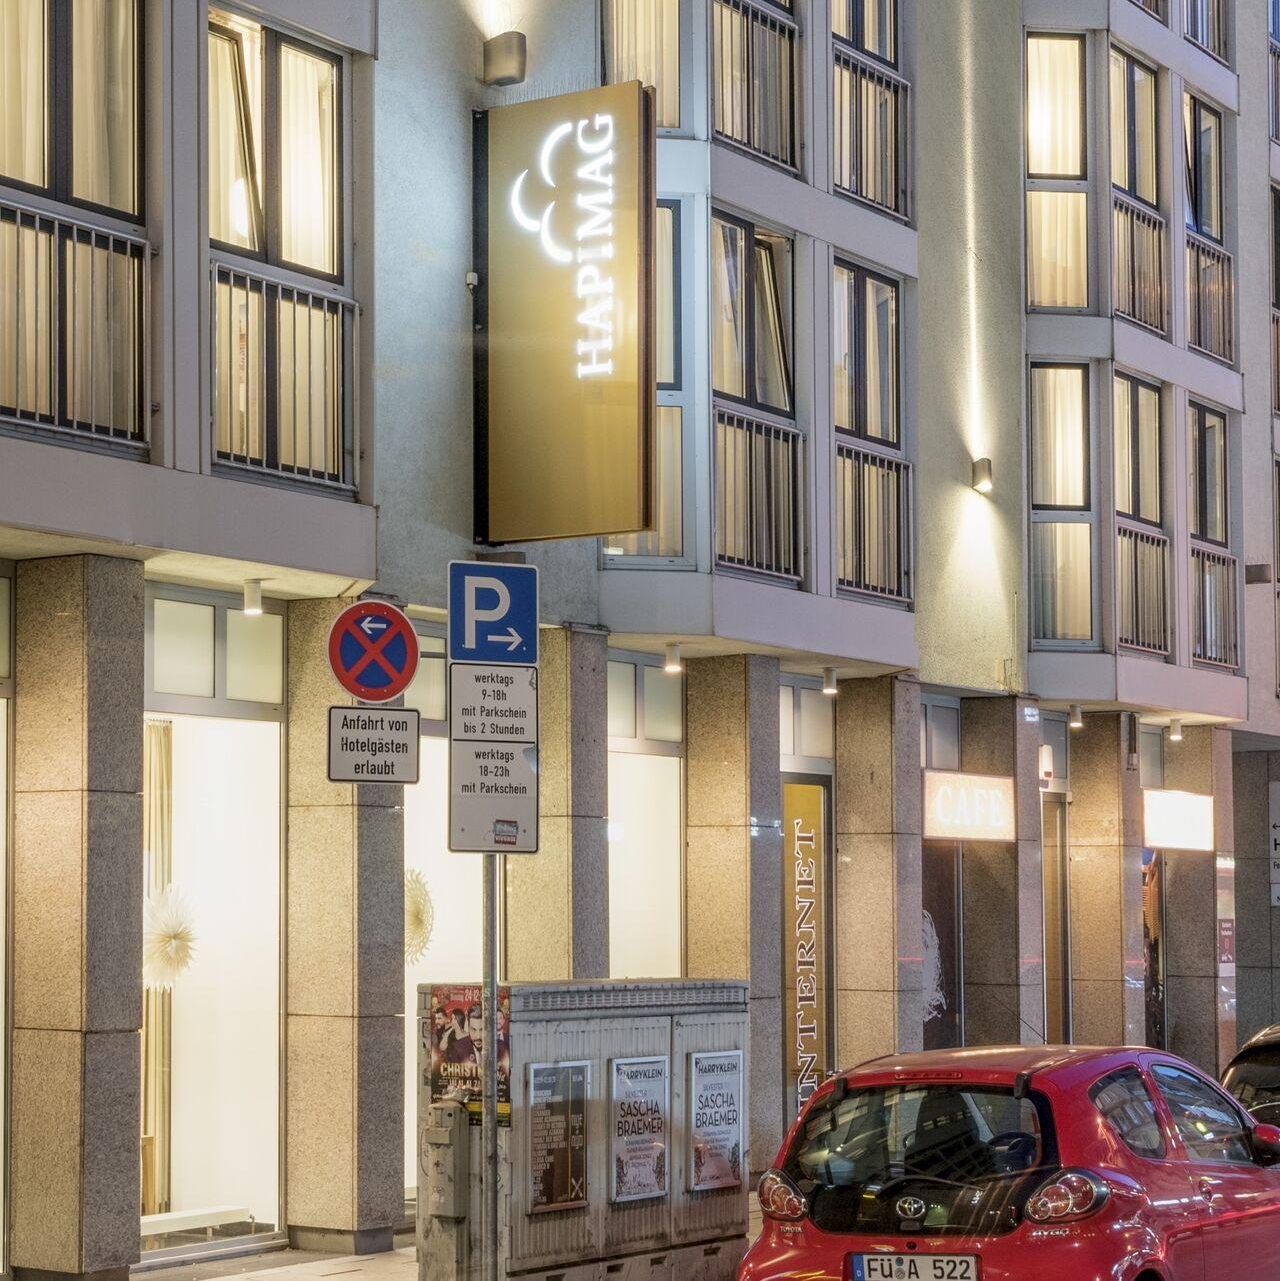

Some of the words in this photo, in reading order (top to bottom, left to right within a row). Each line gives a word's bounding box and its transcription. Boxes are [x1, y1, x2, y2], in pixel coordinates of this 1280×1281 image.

[577, 113, 613, 379] HAPIMAG
[464, 576, 511, 649] P
[474, 673, 514, 687] werktags
[481, 689, 507, 701] 9-18h
[461, 706, 476, 718] mit
[480, 706, 527, 719] Parkschein
[341, 715, 385, 732] Anfahrt
[388, 720, 408, 732] von
[464, 723, 477, 734] bis
[480, 723, 487, 734] 2
[490, 723, 525, 736] Stunden
[341, 737, 408, 756] Hotelgästen
[474, 749, 514, 762] werktags
[354, 760, 395, 776] erlaubt
[479, 765, 510, 777] 18-23h
[461, 782, 476, 794] mit
[480, 782, 527, 795] Parkschein
[699, 1063, 738, 1074] HARRYKLEIN
[620, 1100, 660, 1118] SASCHA
[698, 1093, 735, 1110] SASCHA
[696, 1110, 738, 1128] BRAEMER
[617, 1118, 663, 1137] BRAEMER
[867, 1257, 893, 1280] FÜ
[907, 1258, 920, 1280] A
[933, 1258, 971, 1280] 522
